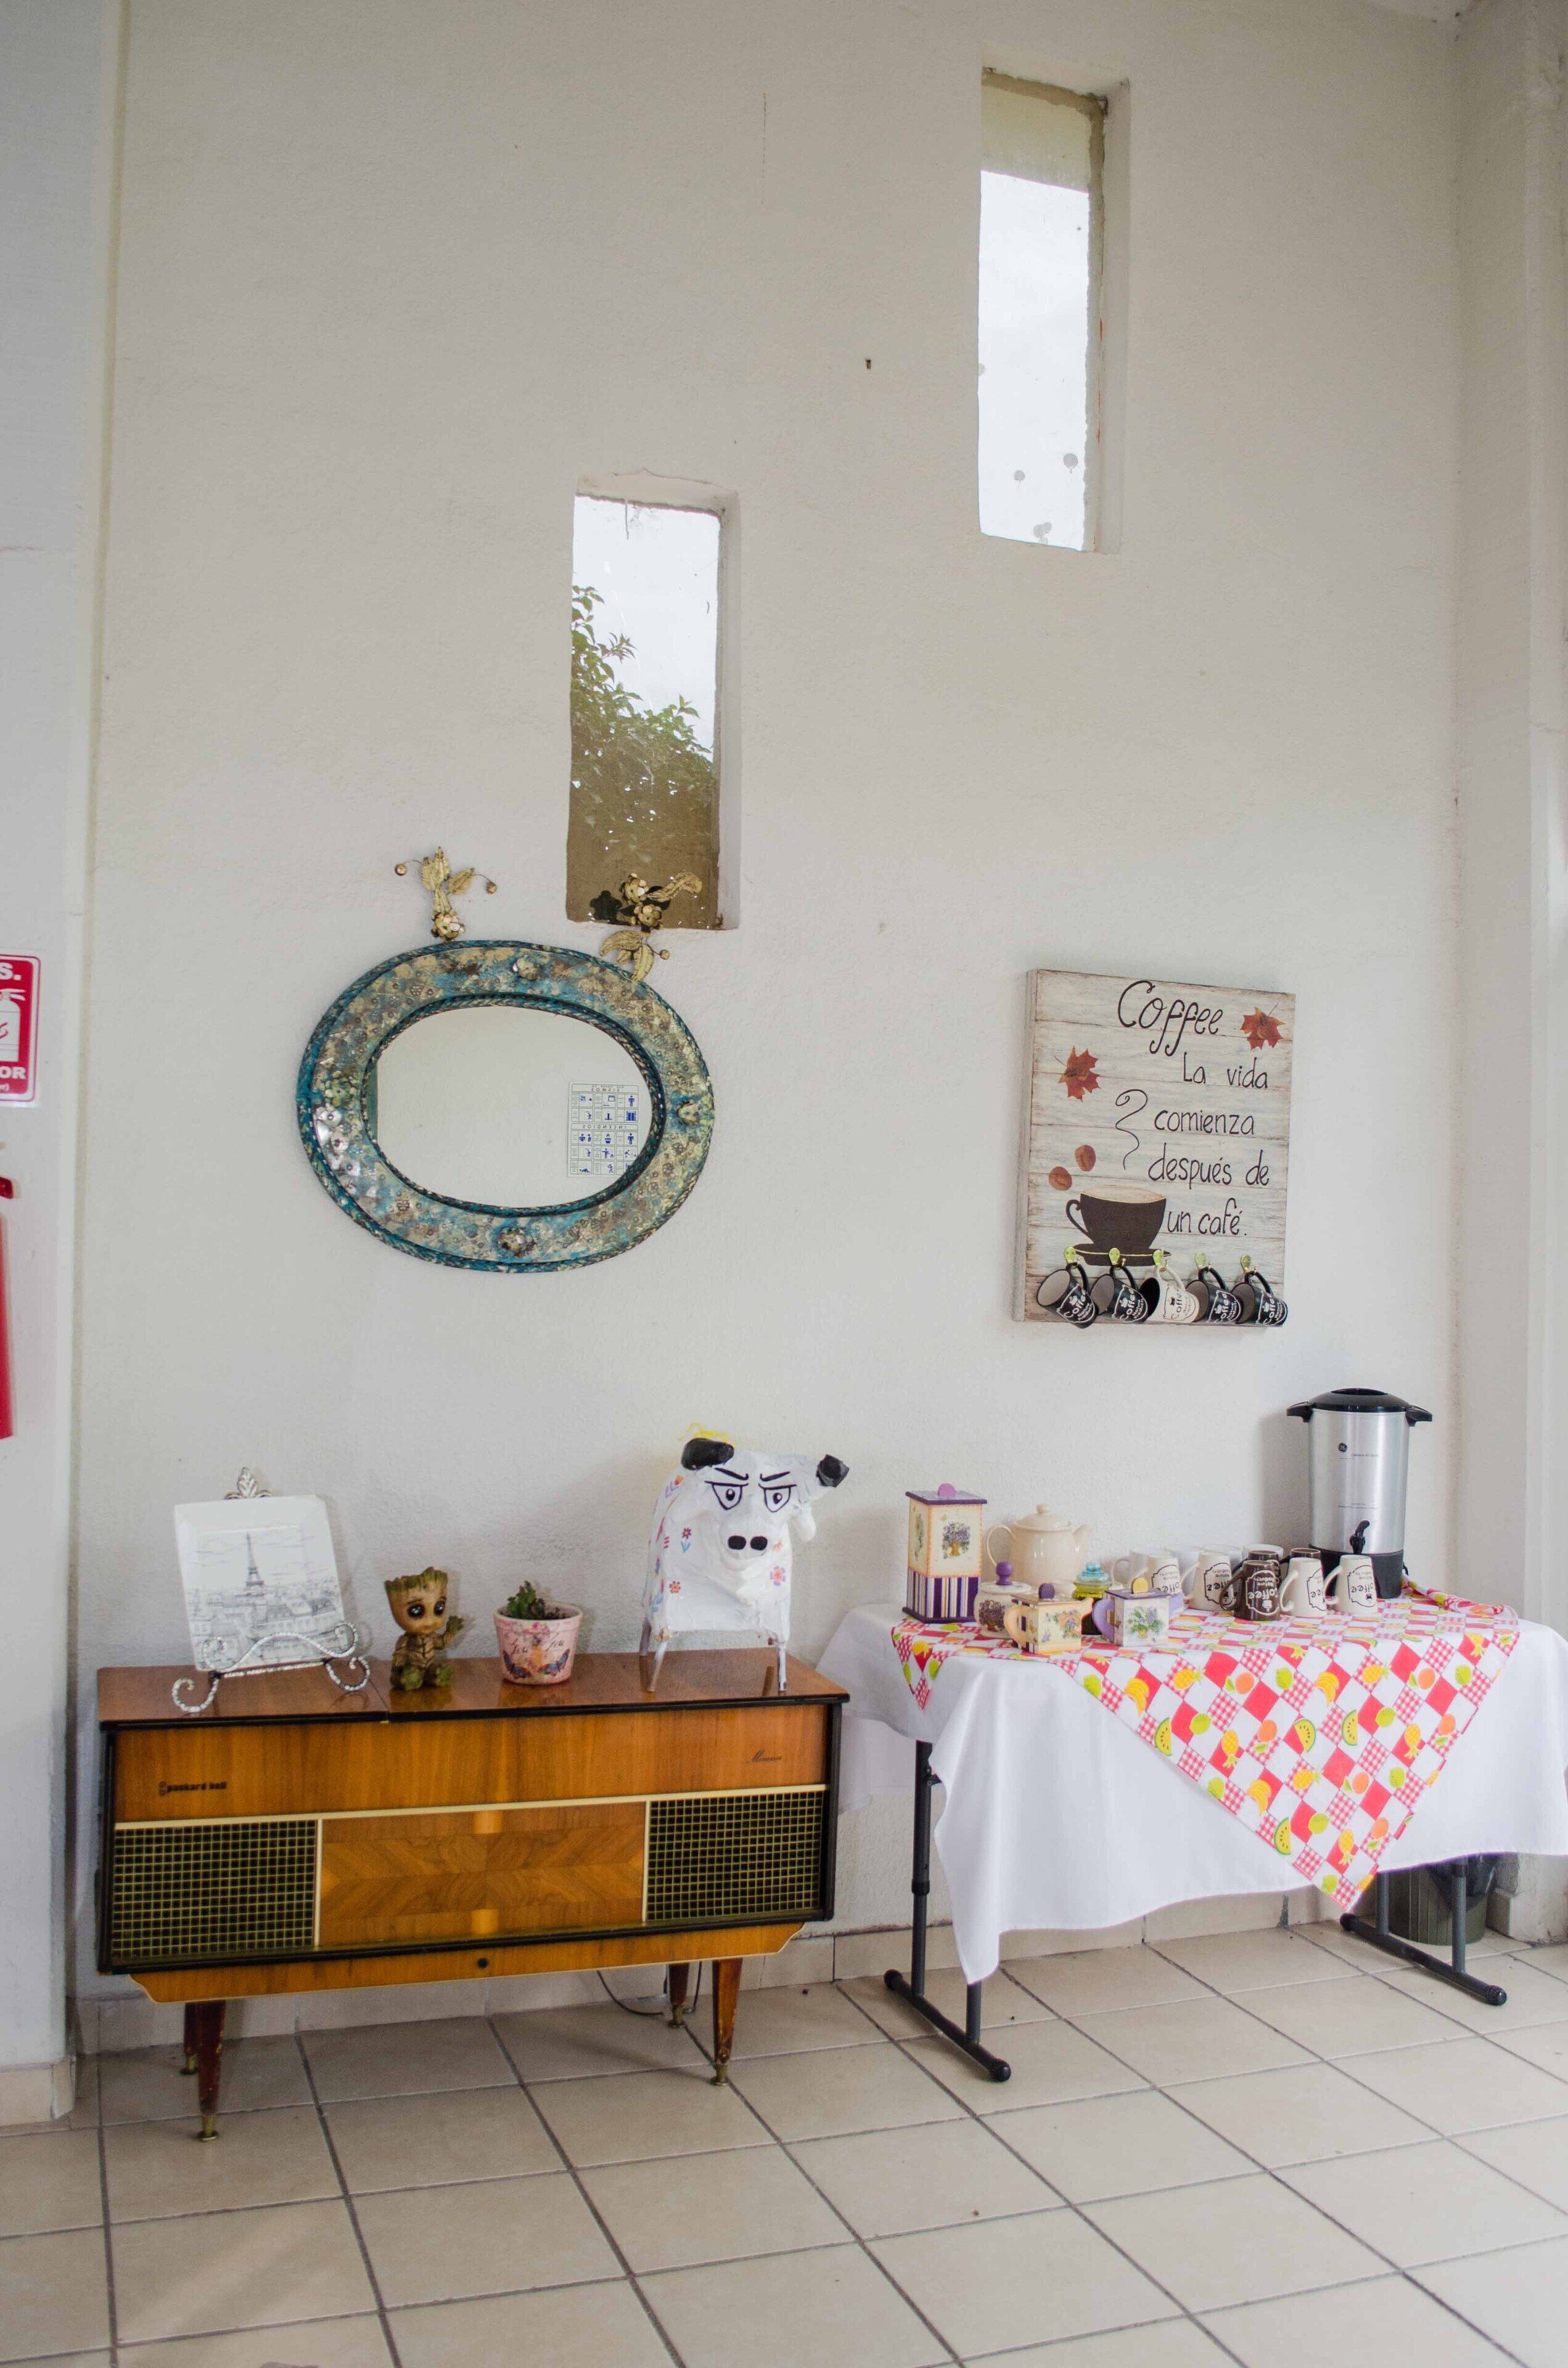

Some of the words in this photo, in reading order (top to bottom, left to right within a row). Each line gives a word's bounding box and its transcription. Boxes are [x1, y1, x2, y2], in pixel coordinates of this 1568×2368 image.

[1117, 980, 1223, 1056] Coffee
[1183, 1051, 1205, 1084] La
[1227, 1057, 1268, 1089] vida
[1154, 1109, 1254, 1135] comienza
[1148, 1142, 1232, 1190] después
[1246, 1149, 1270, 1186] de
[1167, 1211, 1191, 1233] un
[1198, 1197, 1247, 1236] café.
[1064, 1288, 1086, 1318] Coffee
[1119, 1288, 1135, 1320] Coffee
